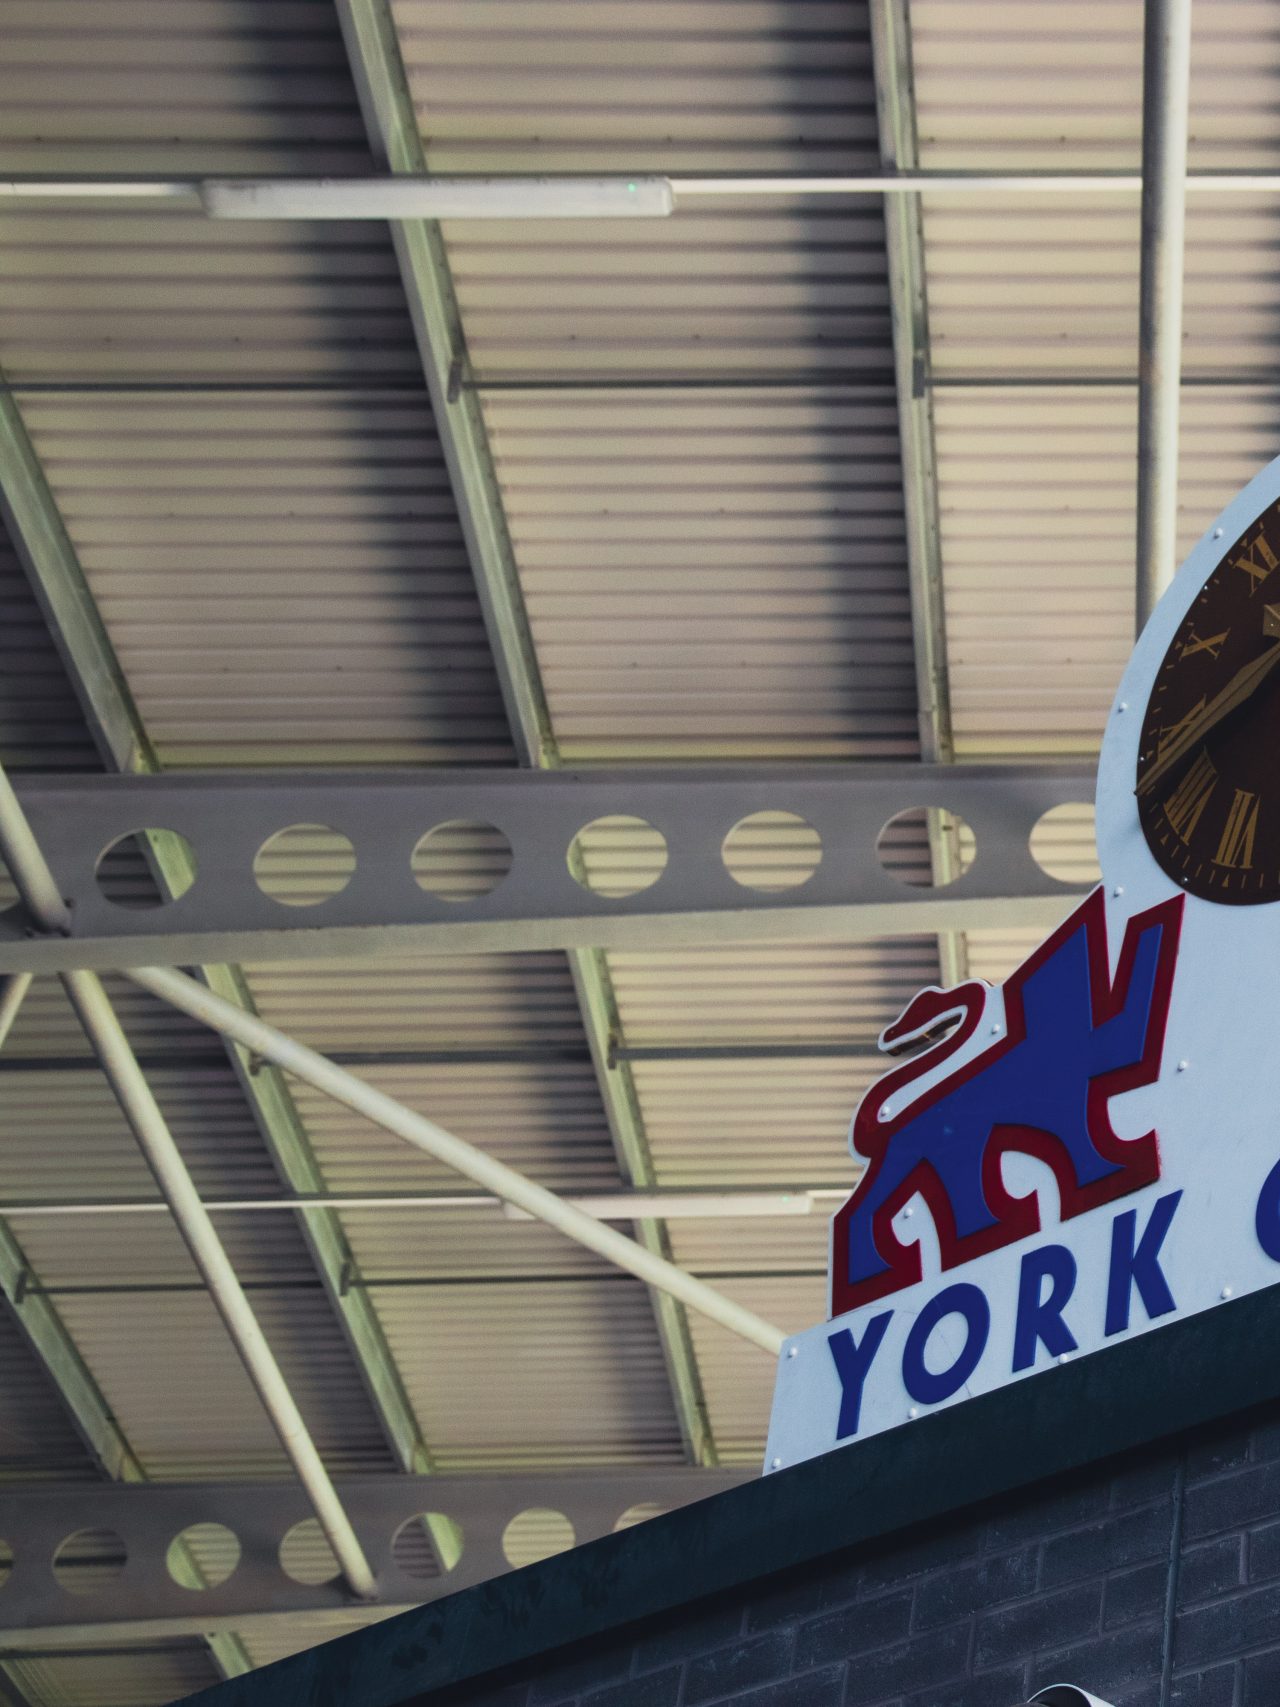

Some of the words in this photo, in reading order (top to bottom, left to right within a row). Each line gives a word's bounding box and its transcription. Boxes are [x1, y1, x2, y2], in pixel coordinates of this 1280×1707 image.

[1179, 627, 1231, 661] X
[1162, 745, 1220, 846] VIII
[1211, 788, 1261, 869] VII
[828, 1190, 1182, 1440] YORK
